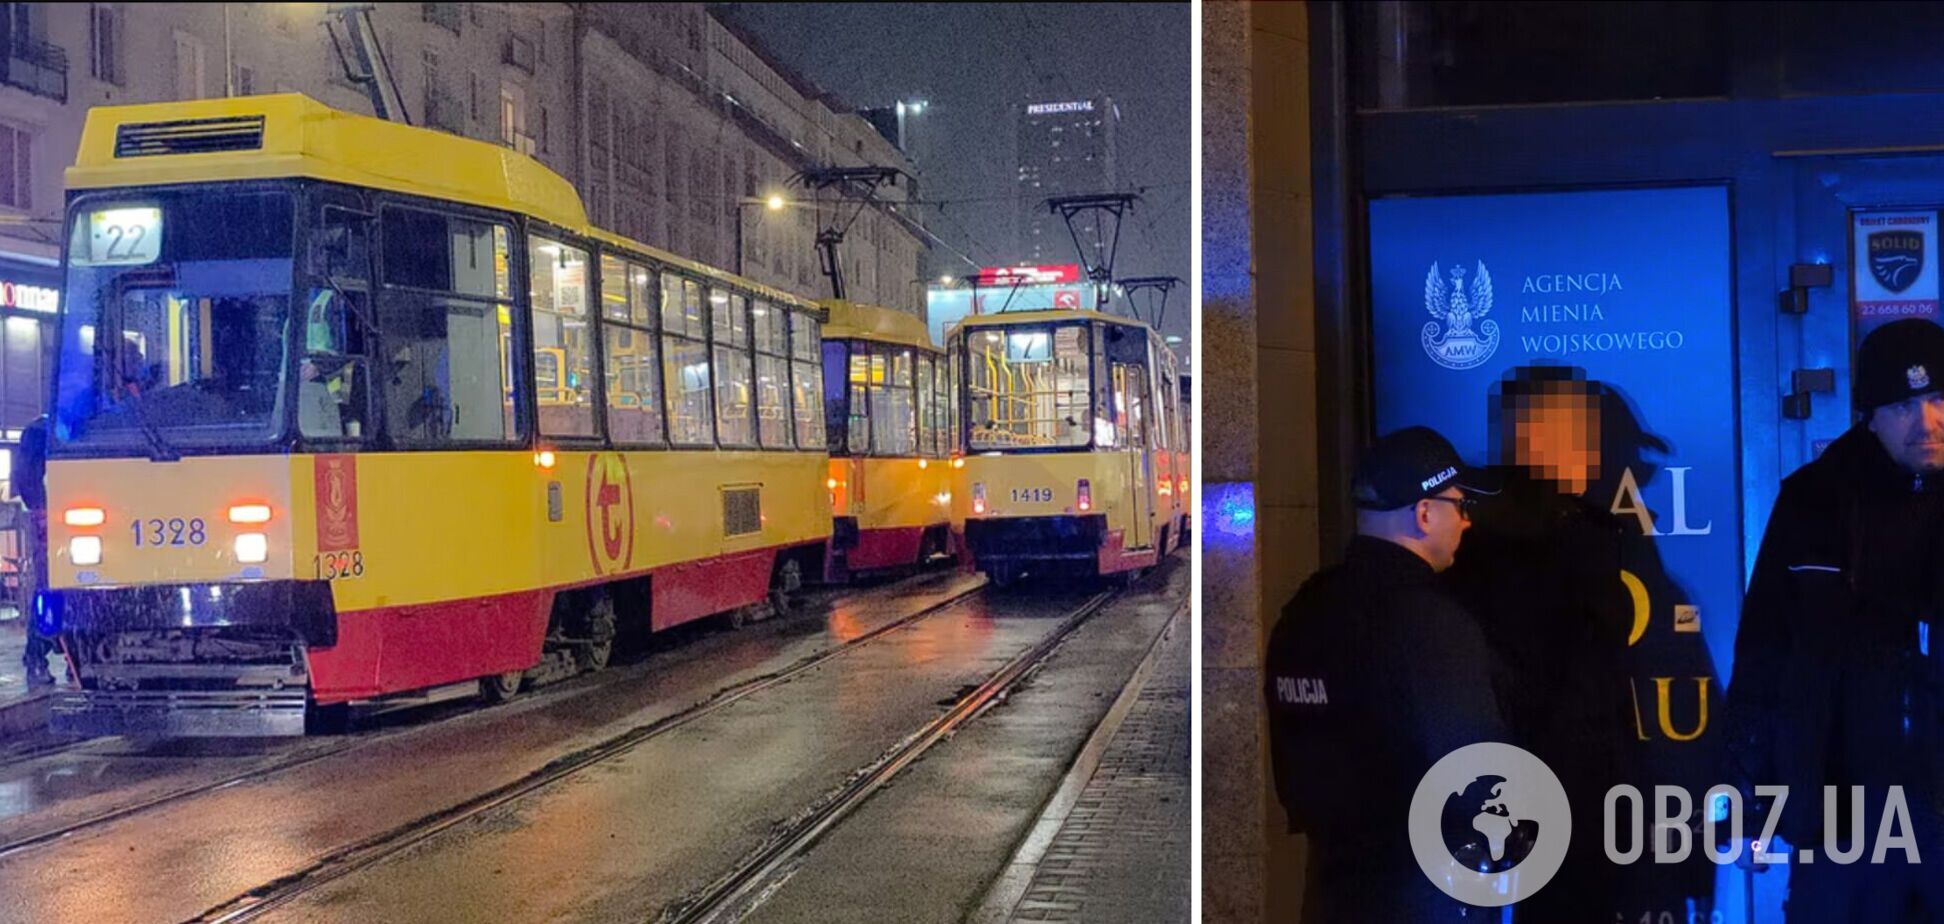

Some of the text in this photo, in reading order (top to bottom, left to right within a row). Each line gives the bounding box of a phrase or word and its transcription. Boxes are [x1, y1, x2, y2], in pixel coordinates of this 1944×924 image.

[1027, 100, 1094, 115] PRESIDENTIAL
[107, 224, 147, 260] 22
[1871, 237, 1920, 251] SOLID
[1522, 273, 1623, 296] AGENCJA
[1521, 304, 1604, 323] MIENIA
[1862, 304, 1876, 316] 22
[1444, 344, 1477, 356] AMW
[1521, 331, 1684, 355] WOJSKOWEGO
[1421, 466, 1458, 491] POLICJA
[1012, 488, 1053, 502] 1419
[130, 518, 205, 547] 1328
[314, 551, 364, 580] 1328
[1276, 676, 1329, 705] POLICJA
